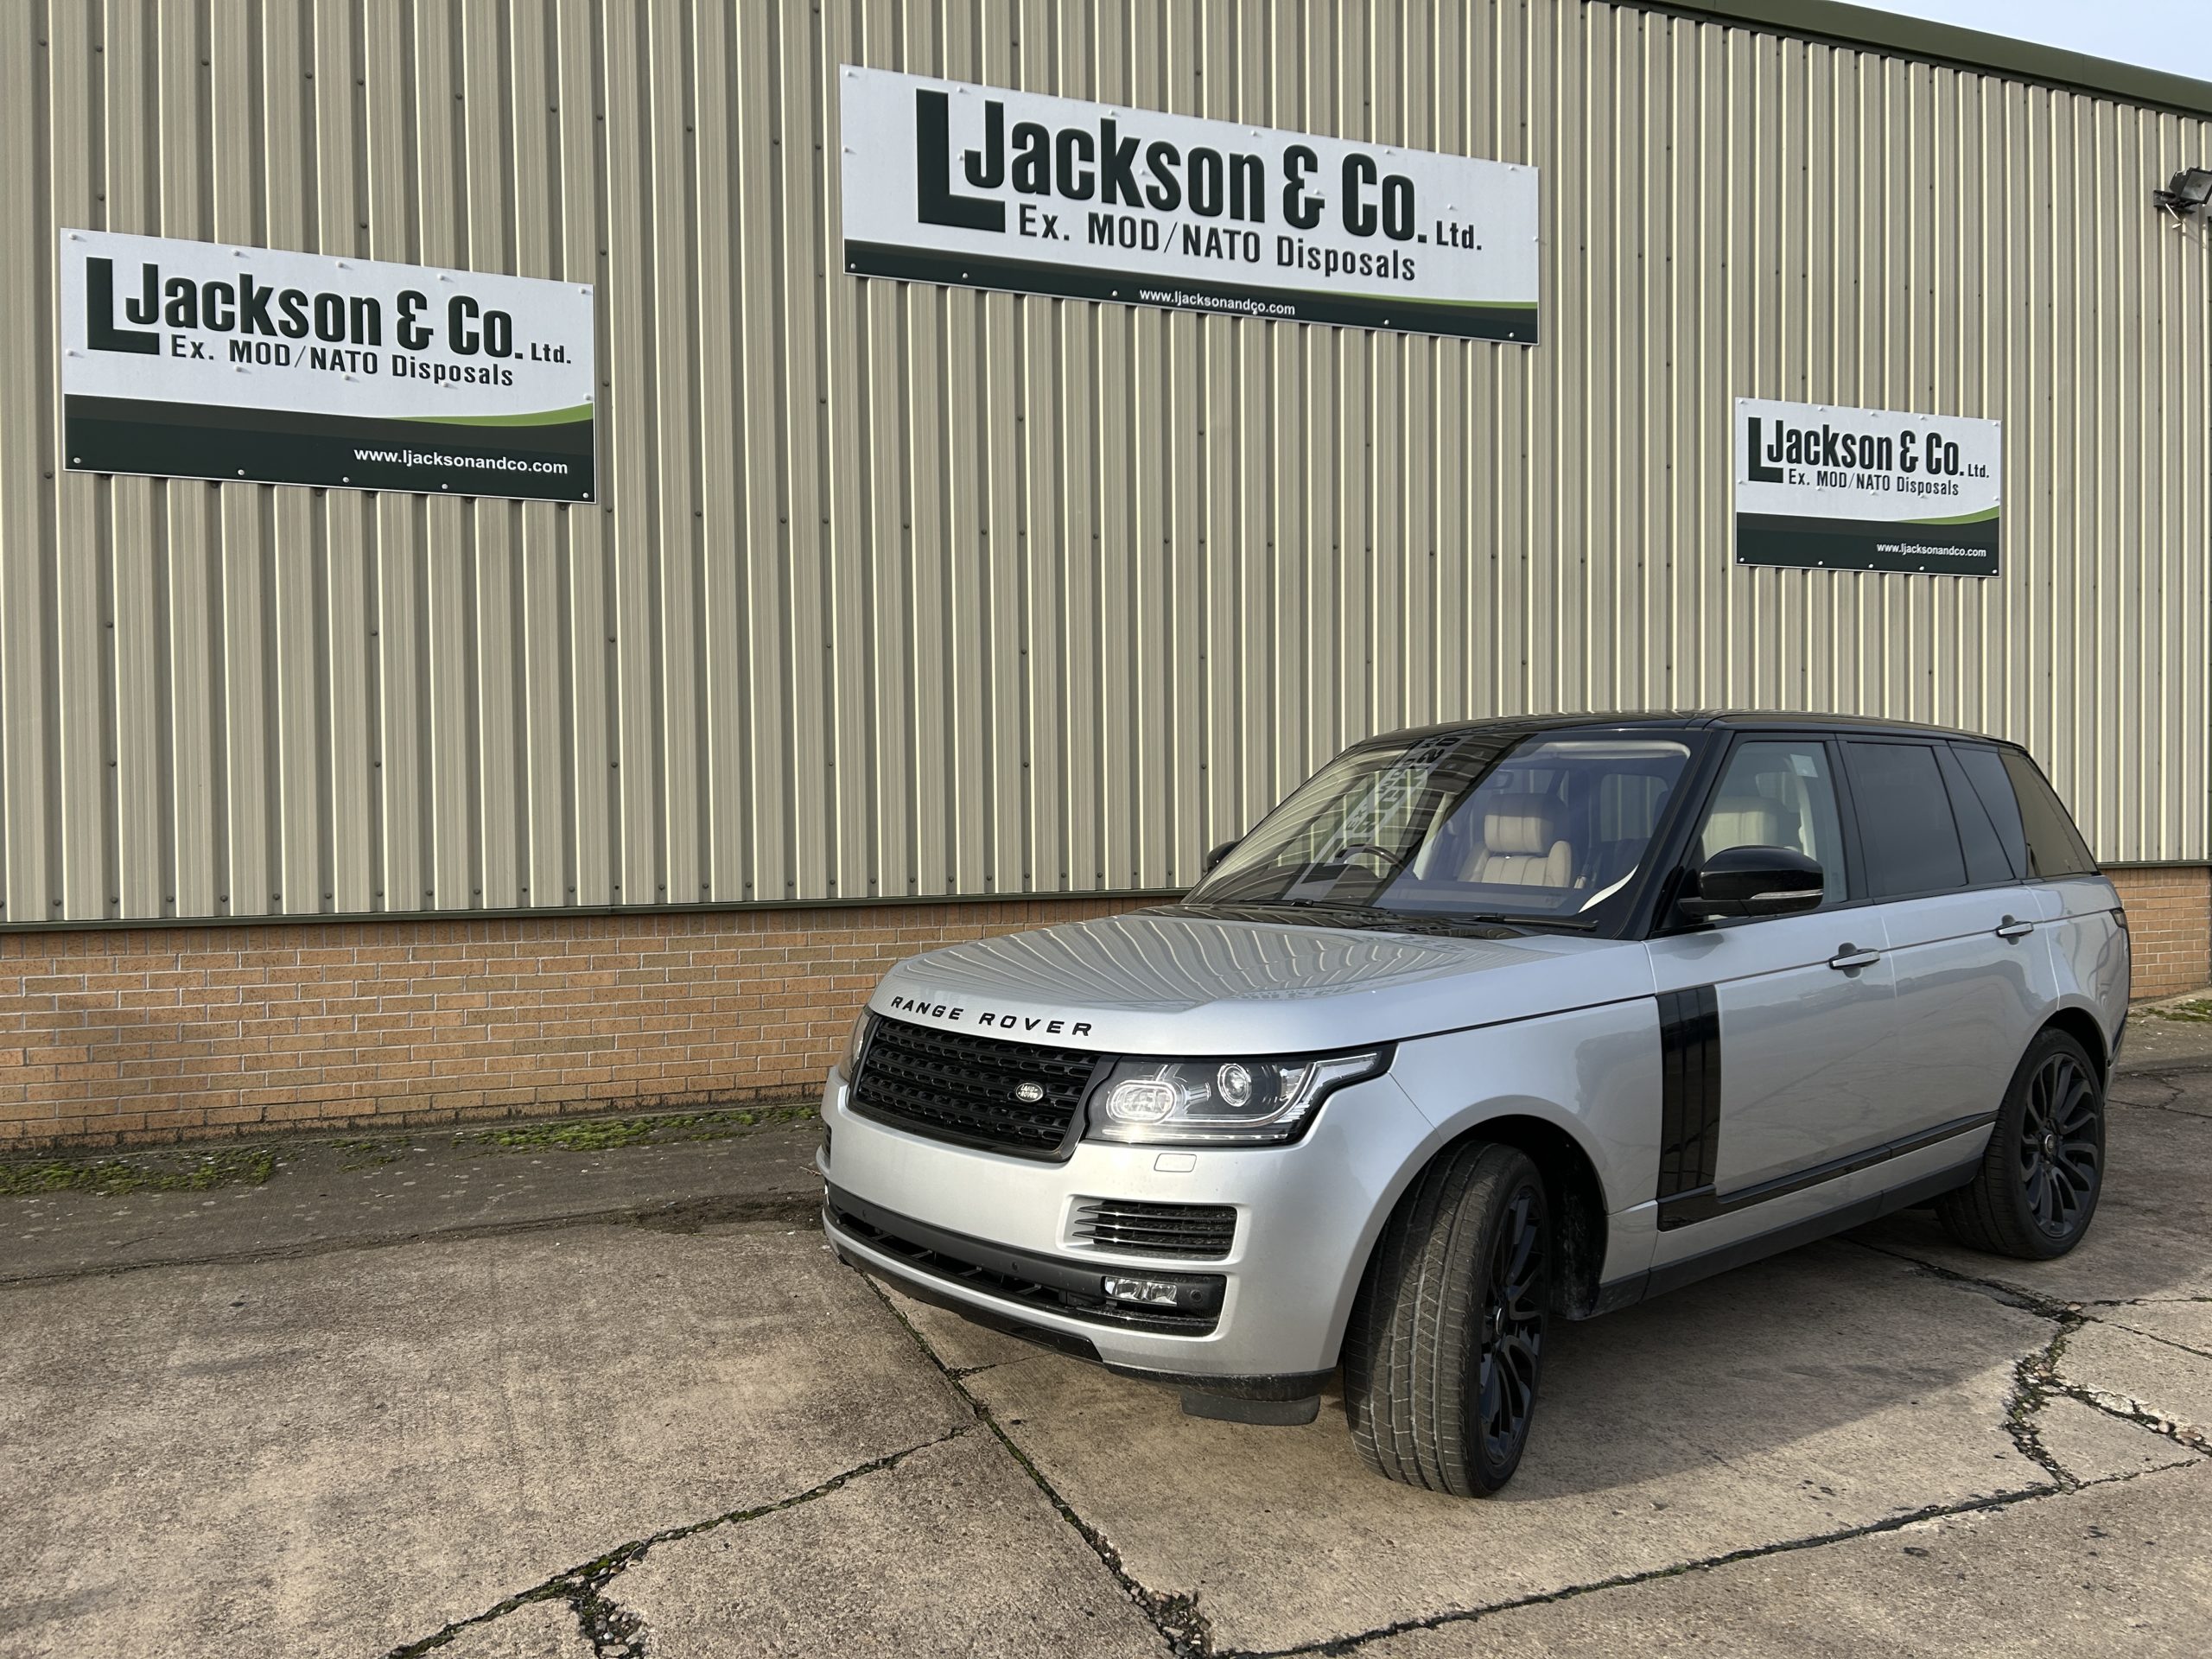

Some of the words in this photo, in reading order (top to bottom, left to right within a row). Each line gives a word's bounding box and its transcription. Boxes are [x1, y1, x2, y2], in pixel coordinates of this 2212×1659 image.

[916, 88, 1266, 234] LJackson
[1282, 144, 1325, 231] &
[1342, 153, 1427, 244] Co.
[1436, 220, 1483, 251] Ltd.
[1019, 203, 1070, 241] Ex.
[1088, 212, 1261, 264] MOD/NATO
[1277, 235, 1415, 282] Disposals
[86, 257, 382, 356] LJackson
[397, 289, 435, 351] &
[448, 295, 524, 360] Co.
[531, 342, 572, 365] Ltd.
[1139, 289, 1296, 315] www.ljacksonandco.com
[171, 334, 214, 361] Ex.
[229, 339, 378, 375] MOD/NATO
[391, 354, 514, 387] Disposals
[353, 448, 569, 474] www.ljacksonandco.com
[1747, 416, 1893, 484] LJackson
[1899, 429, 1919, 474] &
[1925, 432, 1965, 477] Co.
[1967, 463, 1990, 479] Ltd.
[1789, 467, 1810, 486] Ex.
[1816, 470, 1891, 492] MOD/NATO
[1897, 476, 1959, 497] Disposals
[1876, 543, 1986, 557] www.ljacksonandco.com
[890, 995, 964, 1020] RANGE
[978, 1012, 1092, 1037] ROVER
